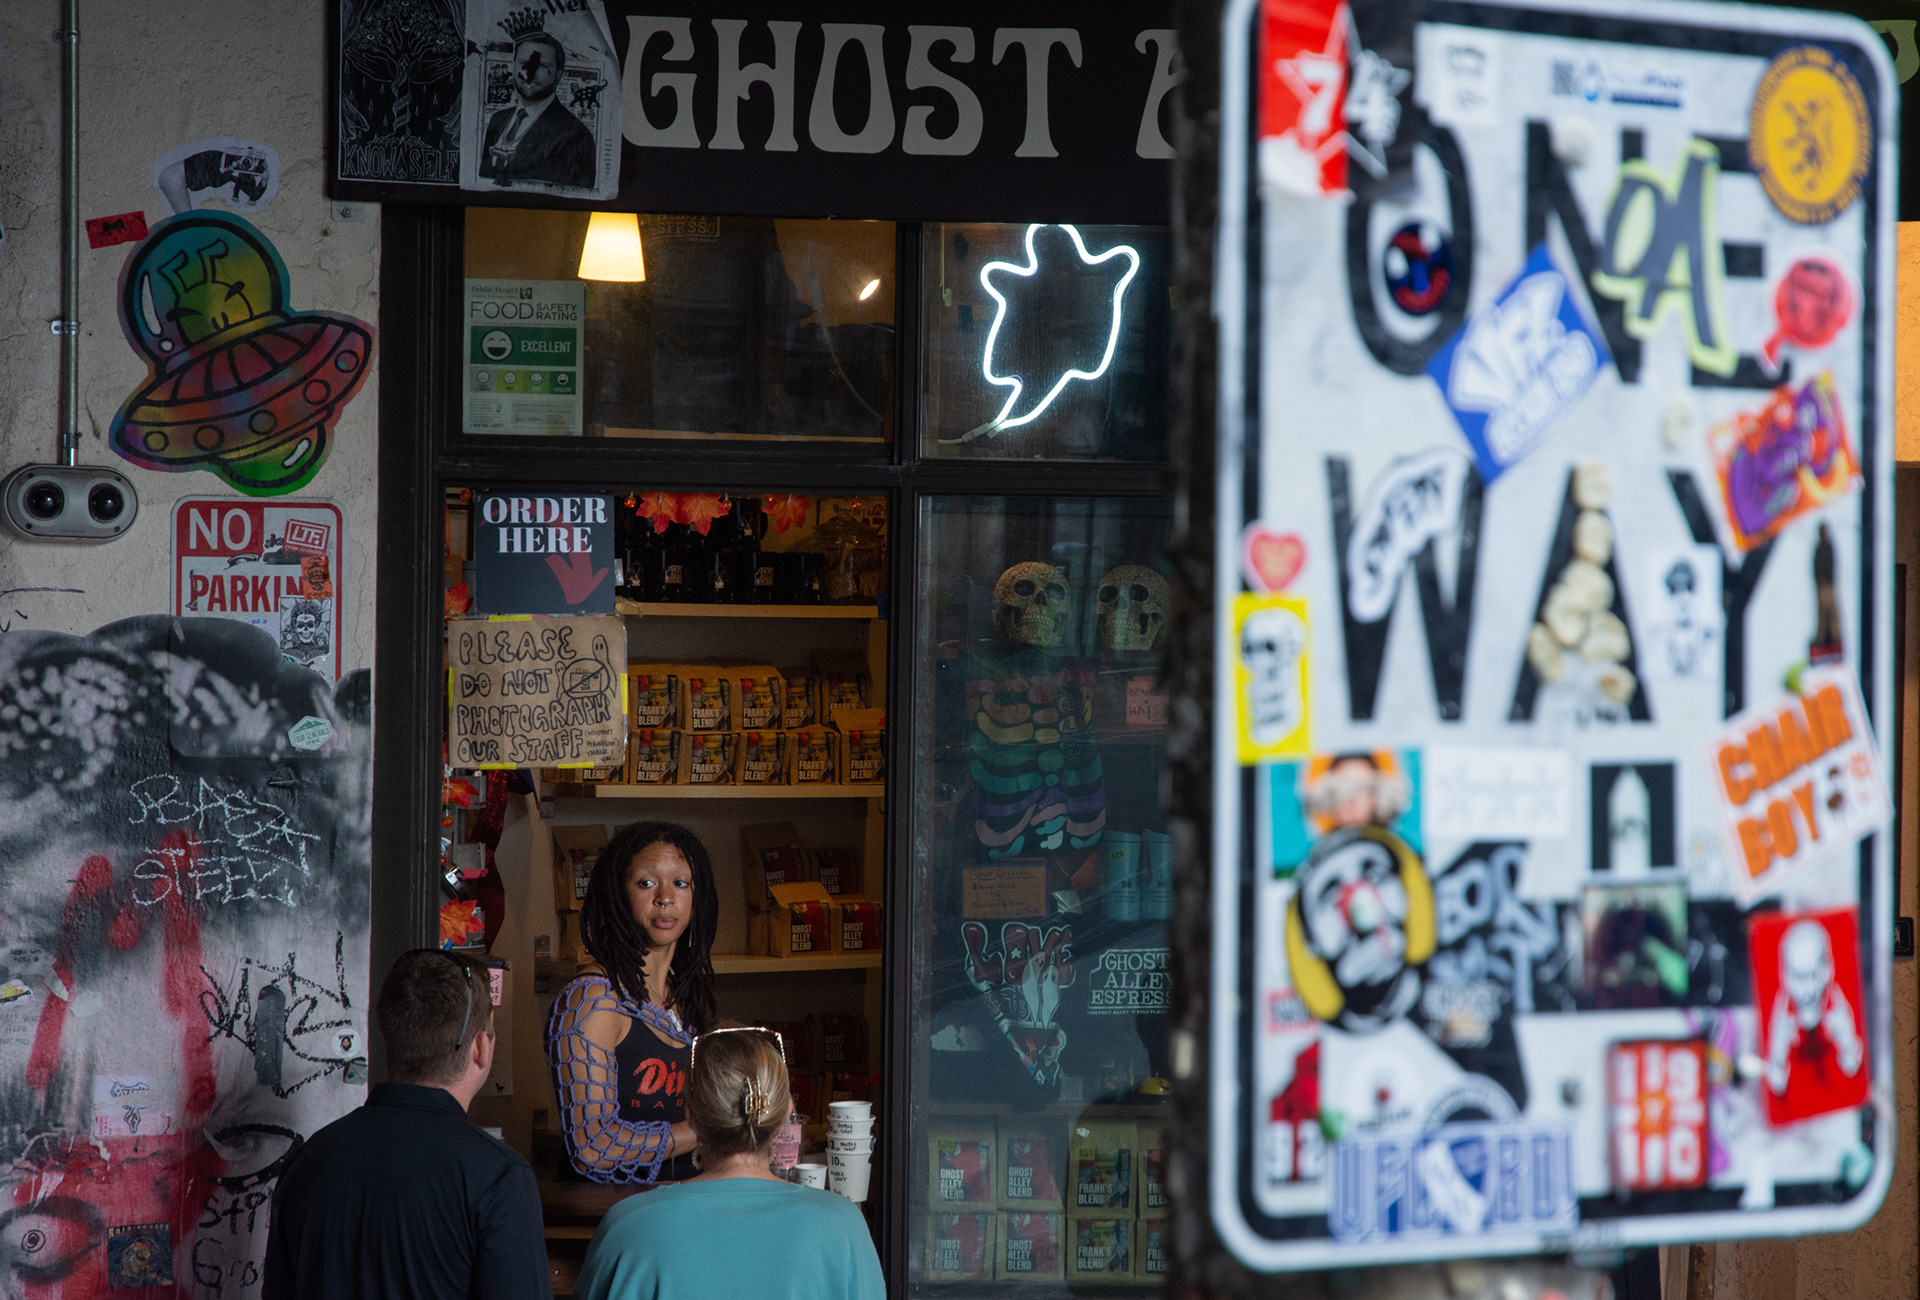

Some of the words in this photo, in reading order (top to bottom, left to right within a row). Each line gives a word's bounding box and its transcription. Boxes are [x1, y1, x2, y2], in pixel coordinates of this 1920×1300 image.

[621, 14, 1083, 158] GHOST
[341, 143, 394, 177] KNOW
[409, 147, 459, 182] SELF
[1347, 118, 1790, 388] ONE
[470, 301, 534, 320] FOOD
[536, 304, 577, 312] SAFETY
[536, 312, 577, 320] RATING
[521, 340, 572, 353] EXCELLENT
[482, 497, 608, 524] ORDER
[189, 507, 252, 551] NO
[497, 526, 592, 553] HERE
[1325, 455, 1780, 721] WAY
[190, 573, 303, 616] PARKIN
[460, 626, 577, 665] PLEASE
[460, 672, 491, 698] DO
[501, 668, 552, 696] NOT
[457, 693, 611, 737] PHOTOGRAPH
[638, 705, 666, 715] FRANK'S
[692, 708, 720, 718] FRANK'S
[743, 708, 770, 717] FRANK'S
[786, 708, 804, 717] ANK'S
[638, 716, 659, 726] BLEND
[693, 718, 714, 728] BLEND
[743, 718, 764, 727] BLEND
[458, 737, 500, 762] OUR
[509, 728, 584, 763] STAFF
[1718, 685, 1853, 806] CHAIR
[638, 761, 666, 771] FRANK'S
[692, 763, 720, 773] FRANK'S
[746, 761, 773, 770] FRANK'S
[799, 760, 825, 770] FRANK'S
[584, 769, 604, 779] BLEND
[637, 771, 659, 781] BLEND
[691, 773, 713, 782] BLEND
[745, 770, 766, 780] BLEND
[799, 770, 819, 779] BLEND
[851, 770, 872, 779] BLEND
[1737, 780, 1818, 878] BOY
[792, 924, 812, 933] GHOST
[843, 923, 863, 931] GHOST
[792, 933, 811, 942] ALLEY
[843, 932, 862, 940] ALLEY
[792, 942, 811, 951] BLEND
[843, 940, 863, 949] BLEND
[1105, 952, 1170, 970] GHOST
[1103, 971, 1172, 989] ALLEY
[1090, 990, 1170, 1005] ESPRESS
[831, 1156, 840, 1166] 10
[940, 1169, 964, 1180] GHOST
[1009, 1166, 1033, 1177] GHOST
[1008, 1177, 1031, 1187] ALLEY
[1008, 1187, 1032, 1197] BLEND
[1079, 1184, 1113, 1194] FRANK'S
[1078, 1194, 1104, 1204] BLEND
[940, 1240, 960, 1250] HOST
[1008, 1240, 1032, 1250] GHOST
[1008, 1250, 1031, 1260] ALLEY
[1078, 1246, 1112, 1257] FRANK'S
[1007, 1260, 1032, 1270] BLEND
[1077, 1257, 1103, 1269] BLEND
